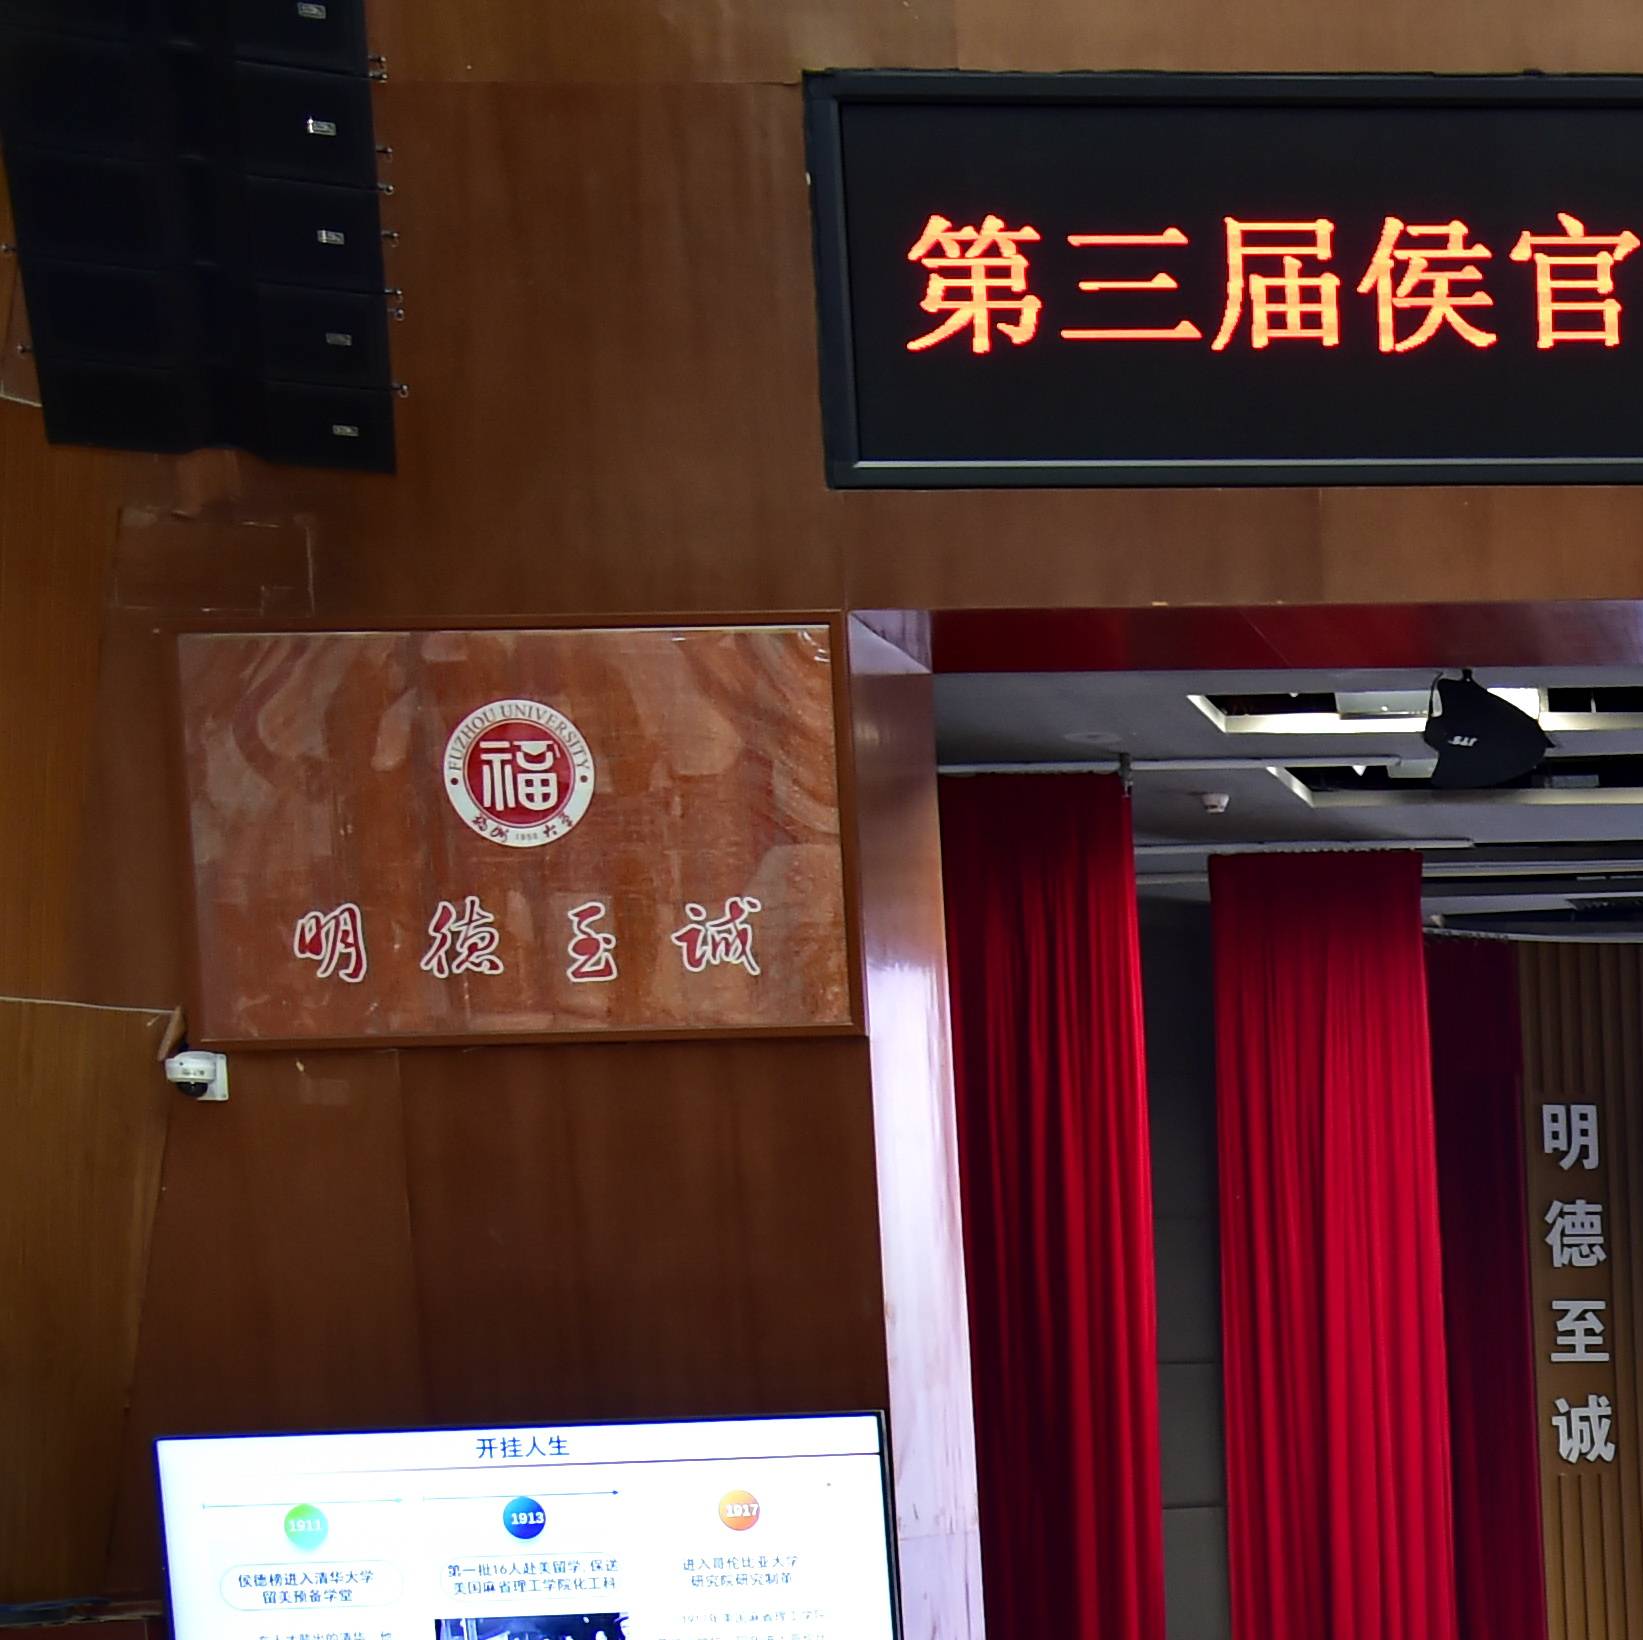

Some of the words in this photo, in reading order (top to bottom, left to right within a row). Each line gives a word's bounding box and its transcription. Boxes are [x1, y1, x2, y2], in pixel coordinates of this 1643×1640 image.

[448, 706, 495, 771] FUZHOU
[500, 704, 590, 770] UNIVERSITY
[1542, 1104, 1616, 1464] 明德至诚
[475, 1435, 571, 1459] 开挂人生
